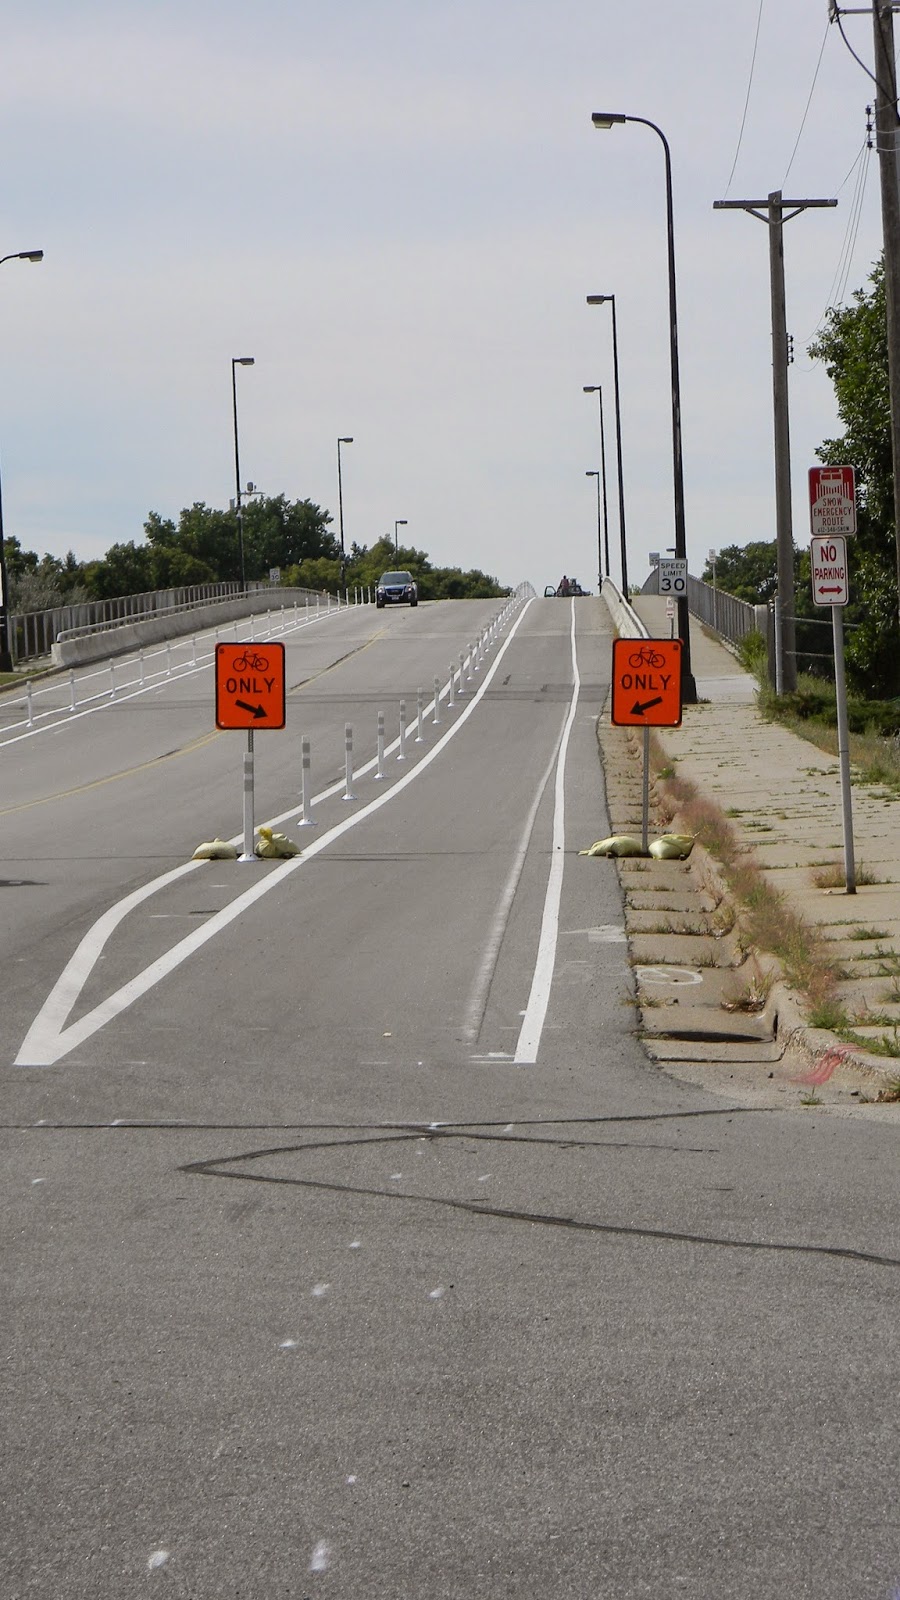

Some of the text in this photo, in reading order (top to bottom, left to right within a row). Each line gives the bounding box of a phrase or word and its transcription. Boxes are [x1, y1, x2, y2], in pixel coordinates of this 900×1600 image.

[822, 497, 842, 506] SNOW
[813, 507, 851, 516] EMERGENCY
[822, 517, 844, 526] ROUTE
[820, 545, 837, 562] NO
[814, 567, 844, 580] PARKING
[661, 578, 685, 591] 30
[226, 677, 276, 694] ONLY
[621, 673, 672, 690] ONLY
